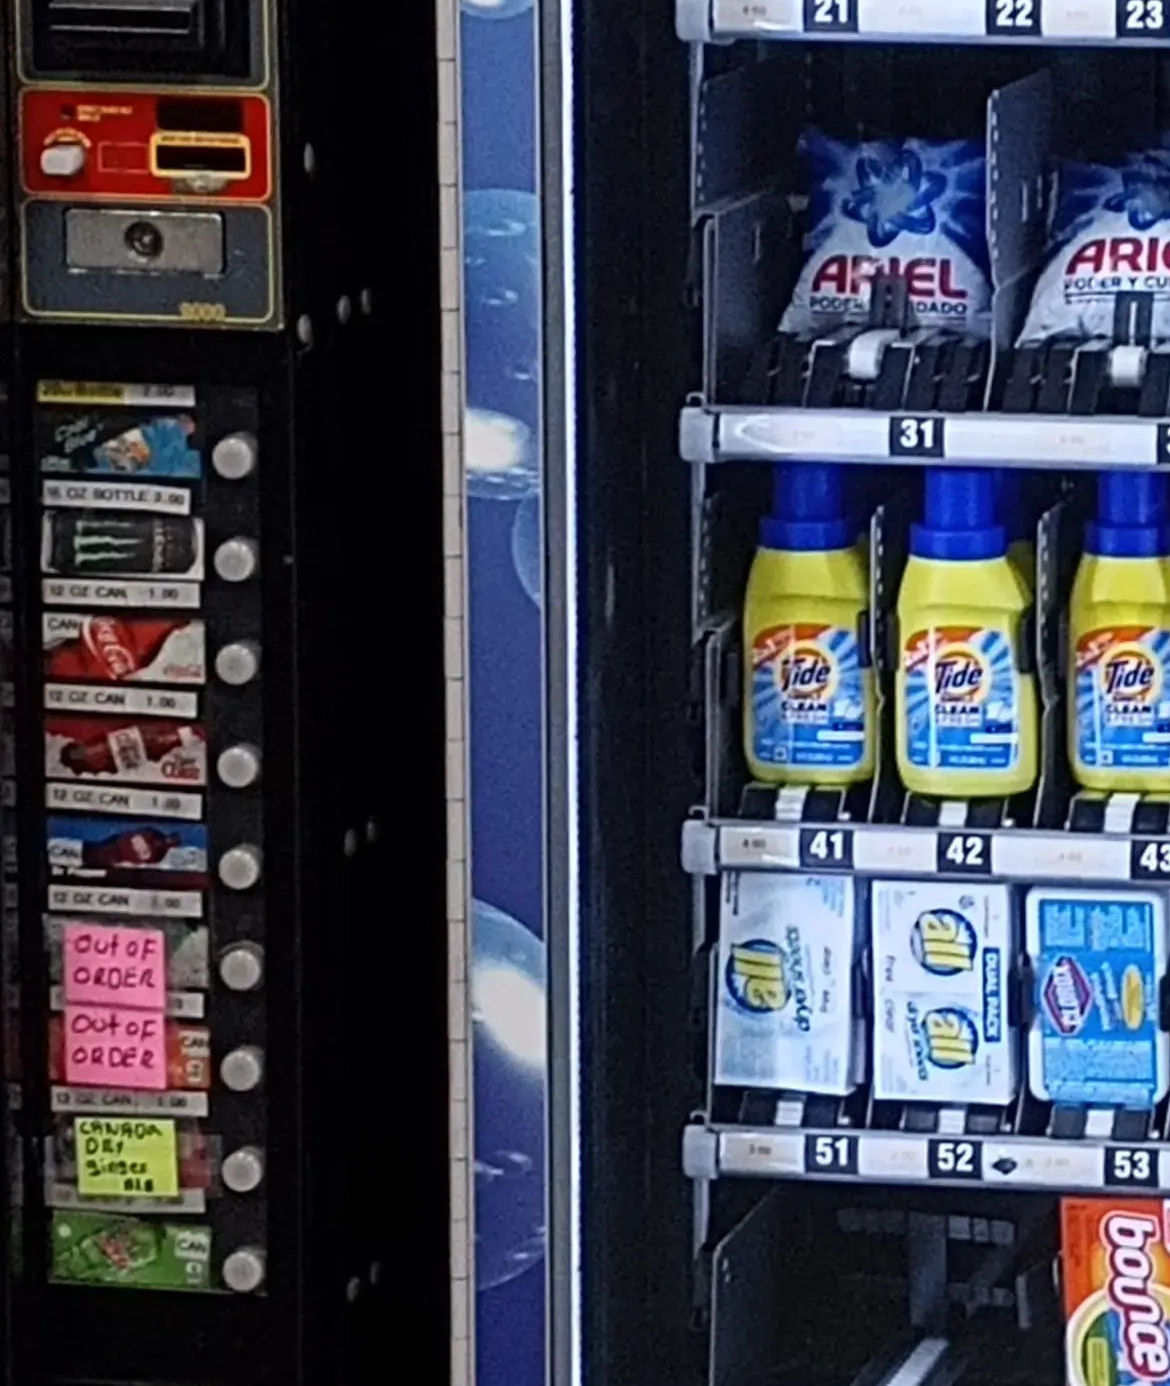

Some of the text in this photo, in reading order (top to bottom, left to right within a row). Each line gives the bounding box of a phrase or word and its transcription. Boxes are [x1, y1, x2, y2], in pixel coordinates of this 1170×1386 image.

[1126, 0, 1163, 28] 23
[1127, 276, 1136, 288] Y
[900, 420, 934, 446] 31
[66, 488, 88, 501] OZ
[93, 489, 147, 503] BOTTLE
[70, 585, 89, 598] OZ
[95, 586, 128, 599] CAN
[48, 616, 79, 631] CAN
[781, 656, 832, 693] Tide
[934, 657, 985, 695] Tide
[1105, 657, 1156, 695] Tide
[69, 691, 88, 704] OZ
[94, 692, 126, 706] CAN
[72, 790, 94, 803] OZ
[99, 792, 130, 807] CAN
[810, 832, 844, 858] 41
[946, 838, 984, 864] 42
[72, 892, 93, 905] OZ
[97, 893, 130, 906] CAN
[918, 911, 975, 973] all
[73, 966, 156, 990] ORDER
[924, 1011, 976, 1066] all
[72, 1045, 156, 1070] ORDER
[815, 1138, 848, 1166] 51
[937, 1143, 974, 1170] 52
[1113, 1151, 1150, 1179] 53
